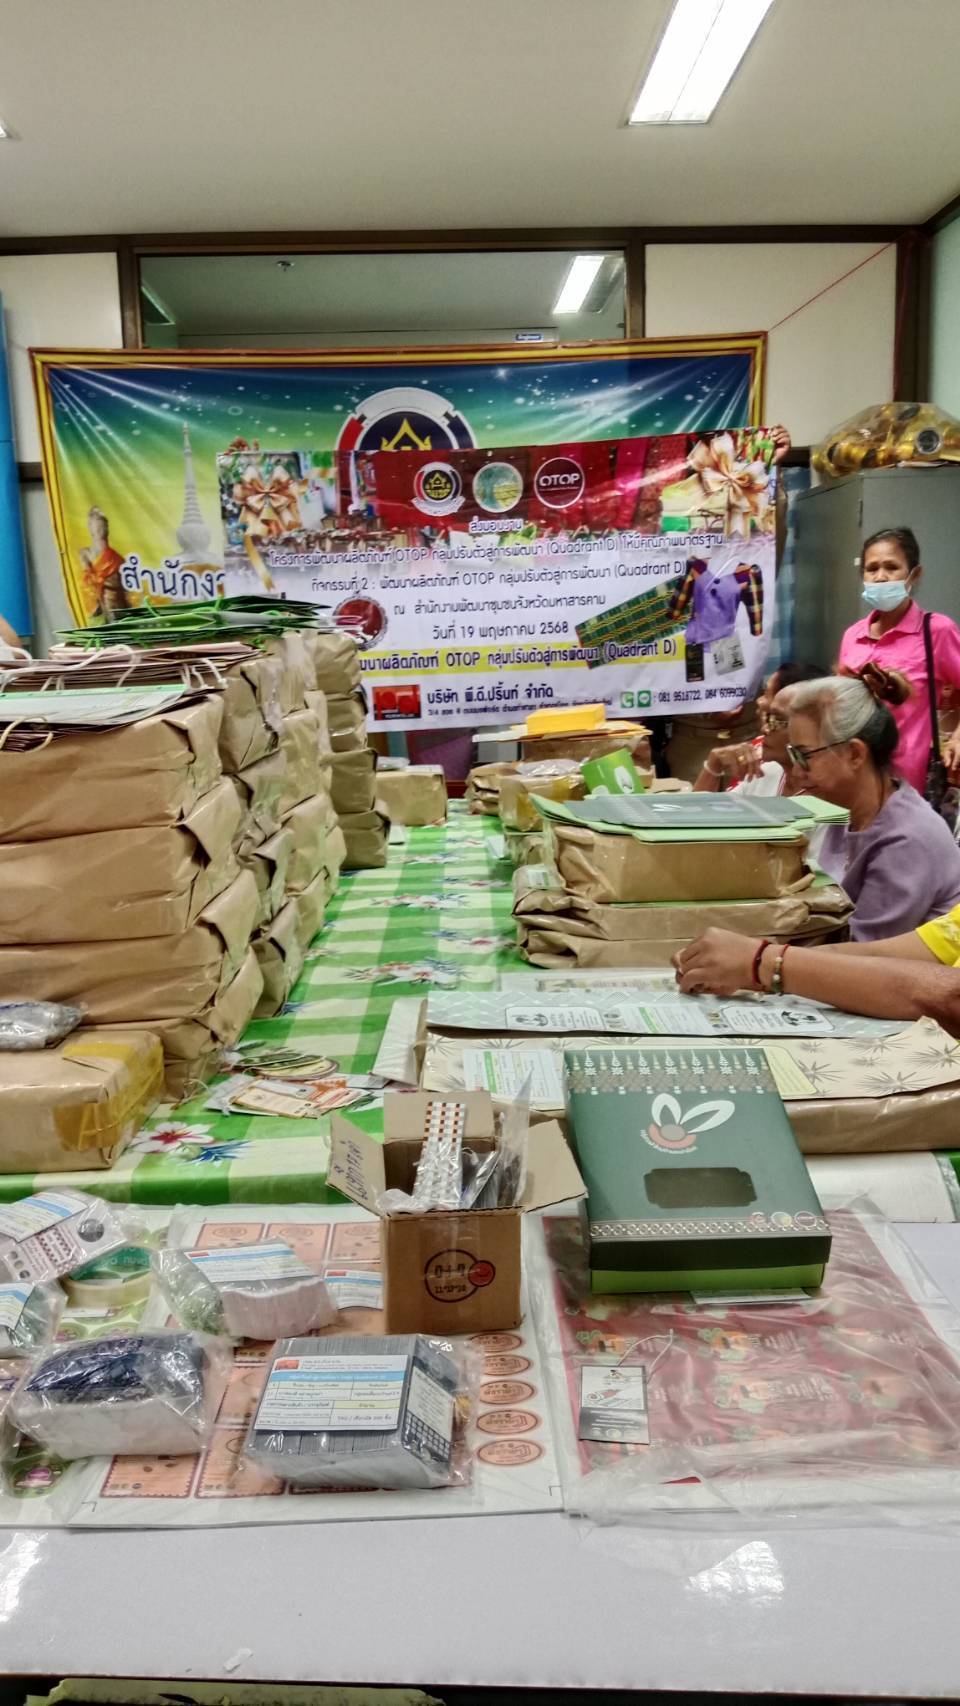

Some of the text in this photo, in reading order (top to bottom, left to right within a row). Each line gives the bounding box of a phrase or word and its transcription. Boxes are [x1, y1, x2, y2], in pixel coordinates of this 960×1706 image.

[539, 472, 580, 488] OTOP
[470, 516, 523, 532] ส่งมอบงาน
[396, 548, 428, 562] OTOP
[361, 577, 368, 590] 2
[463, 571, 495, 586] OTOP
[614, 561, 670, 578] (Quadrant
[674, 560, 686, 575] D)
[394, 605, 405, 615] ณ
[433, 620, 569, 642] วันที่ 19 พฤษภาคม 2568
[446, 652, 481, 667] OTOP
[604, 641, 658, 659] (Quadrant
[663, 636, 677, 656] D)
[427, 688, 458, 704] บริษัท
[525, 683, 554, 699] จำกัด
